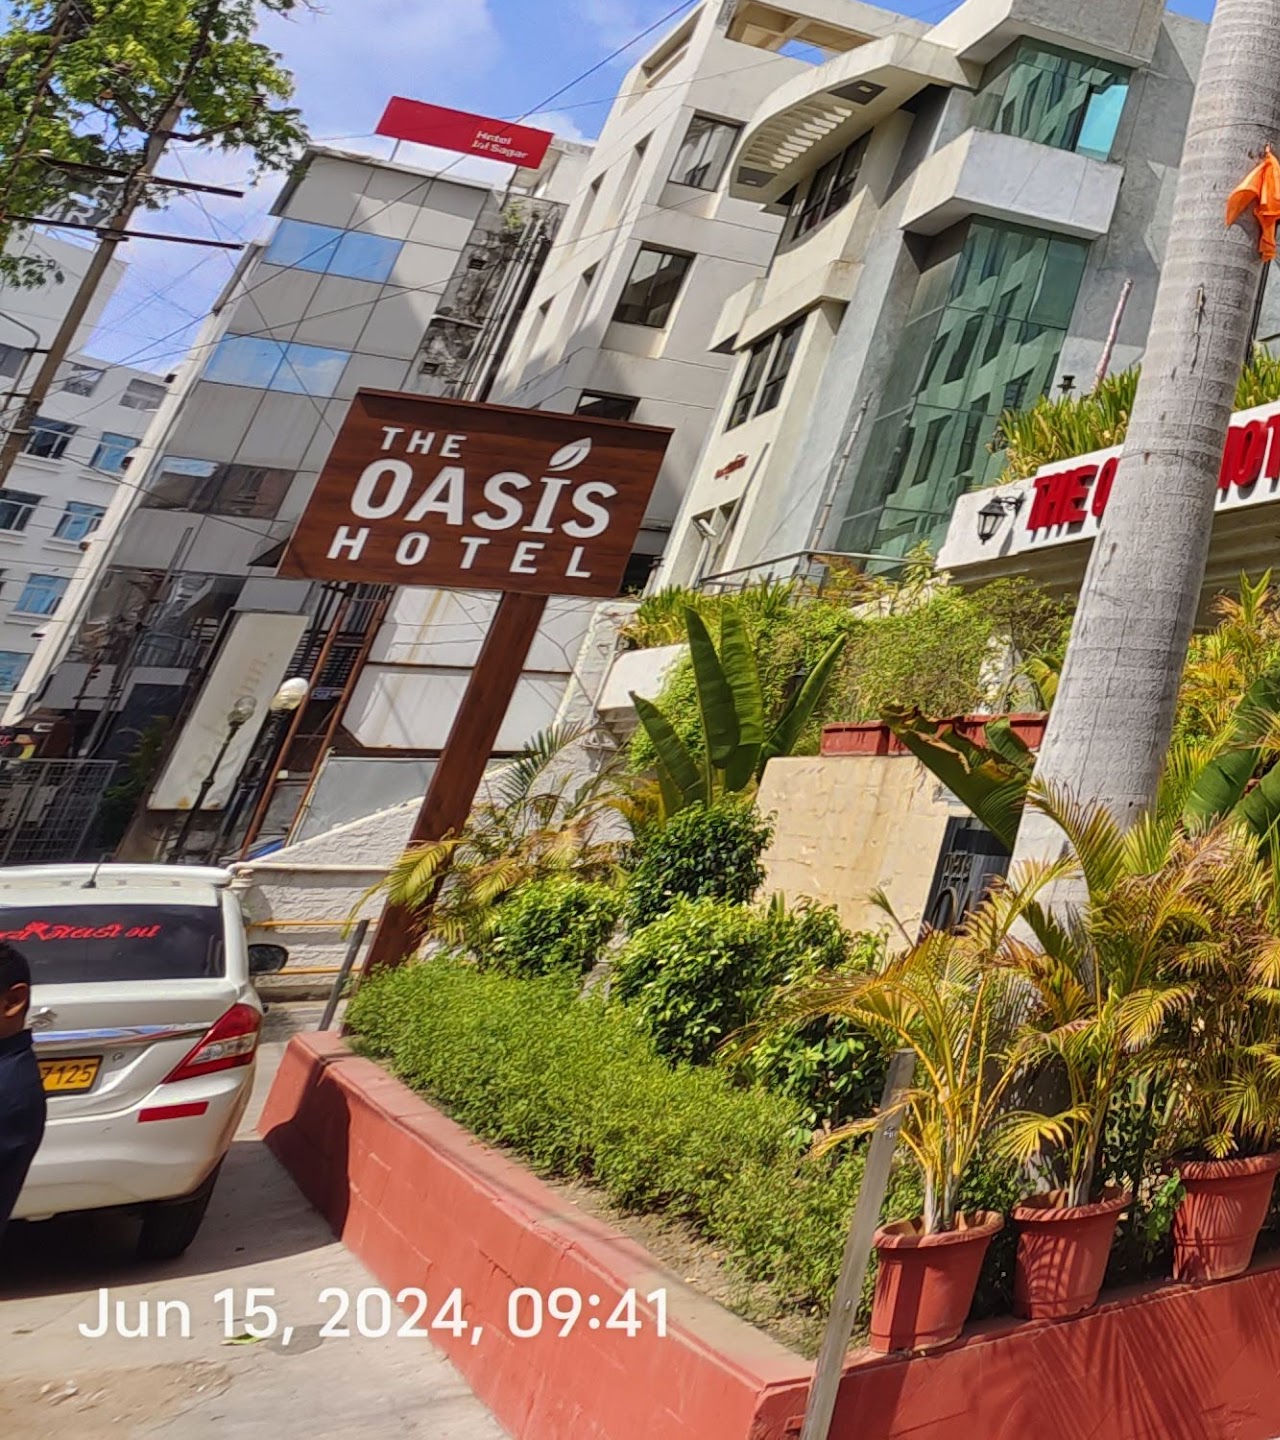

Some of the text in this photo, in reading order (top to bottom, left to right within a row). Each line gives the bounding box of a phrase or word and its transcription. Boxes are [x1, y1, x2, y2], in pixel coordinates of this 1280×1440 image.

[476, 130, 513, 145] Hotel
[490, 144, 529, 158] Sagar
[380, 426, 467, 458] THE
[350, 458, 618, 538] OASIS
[1026, 464, 1100, 530] THE
[326, 525, 592, 579] HOTEL
